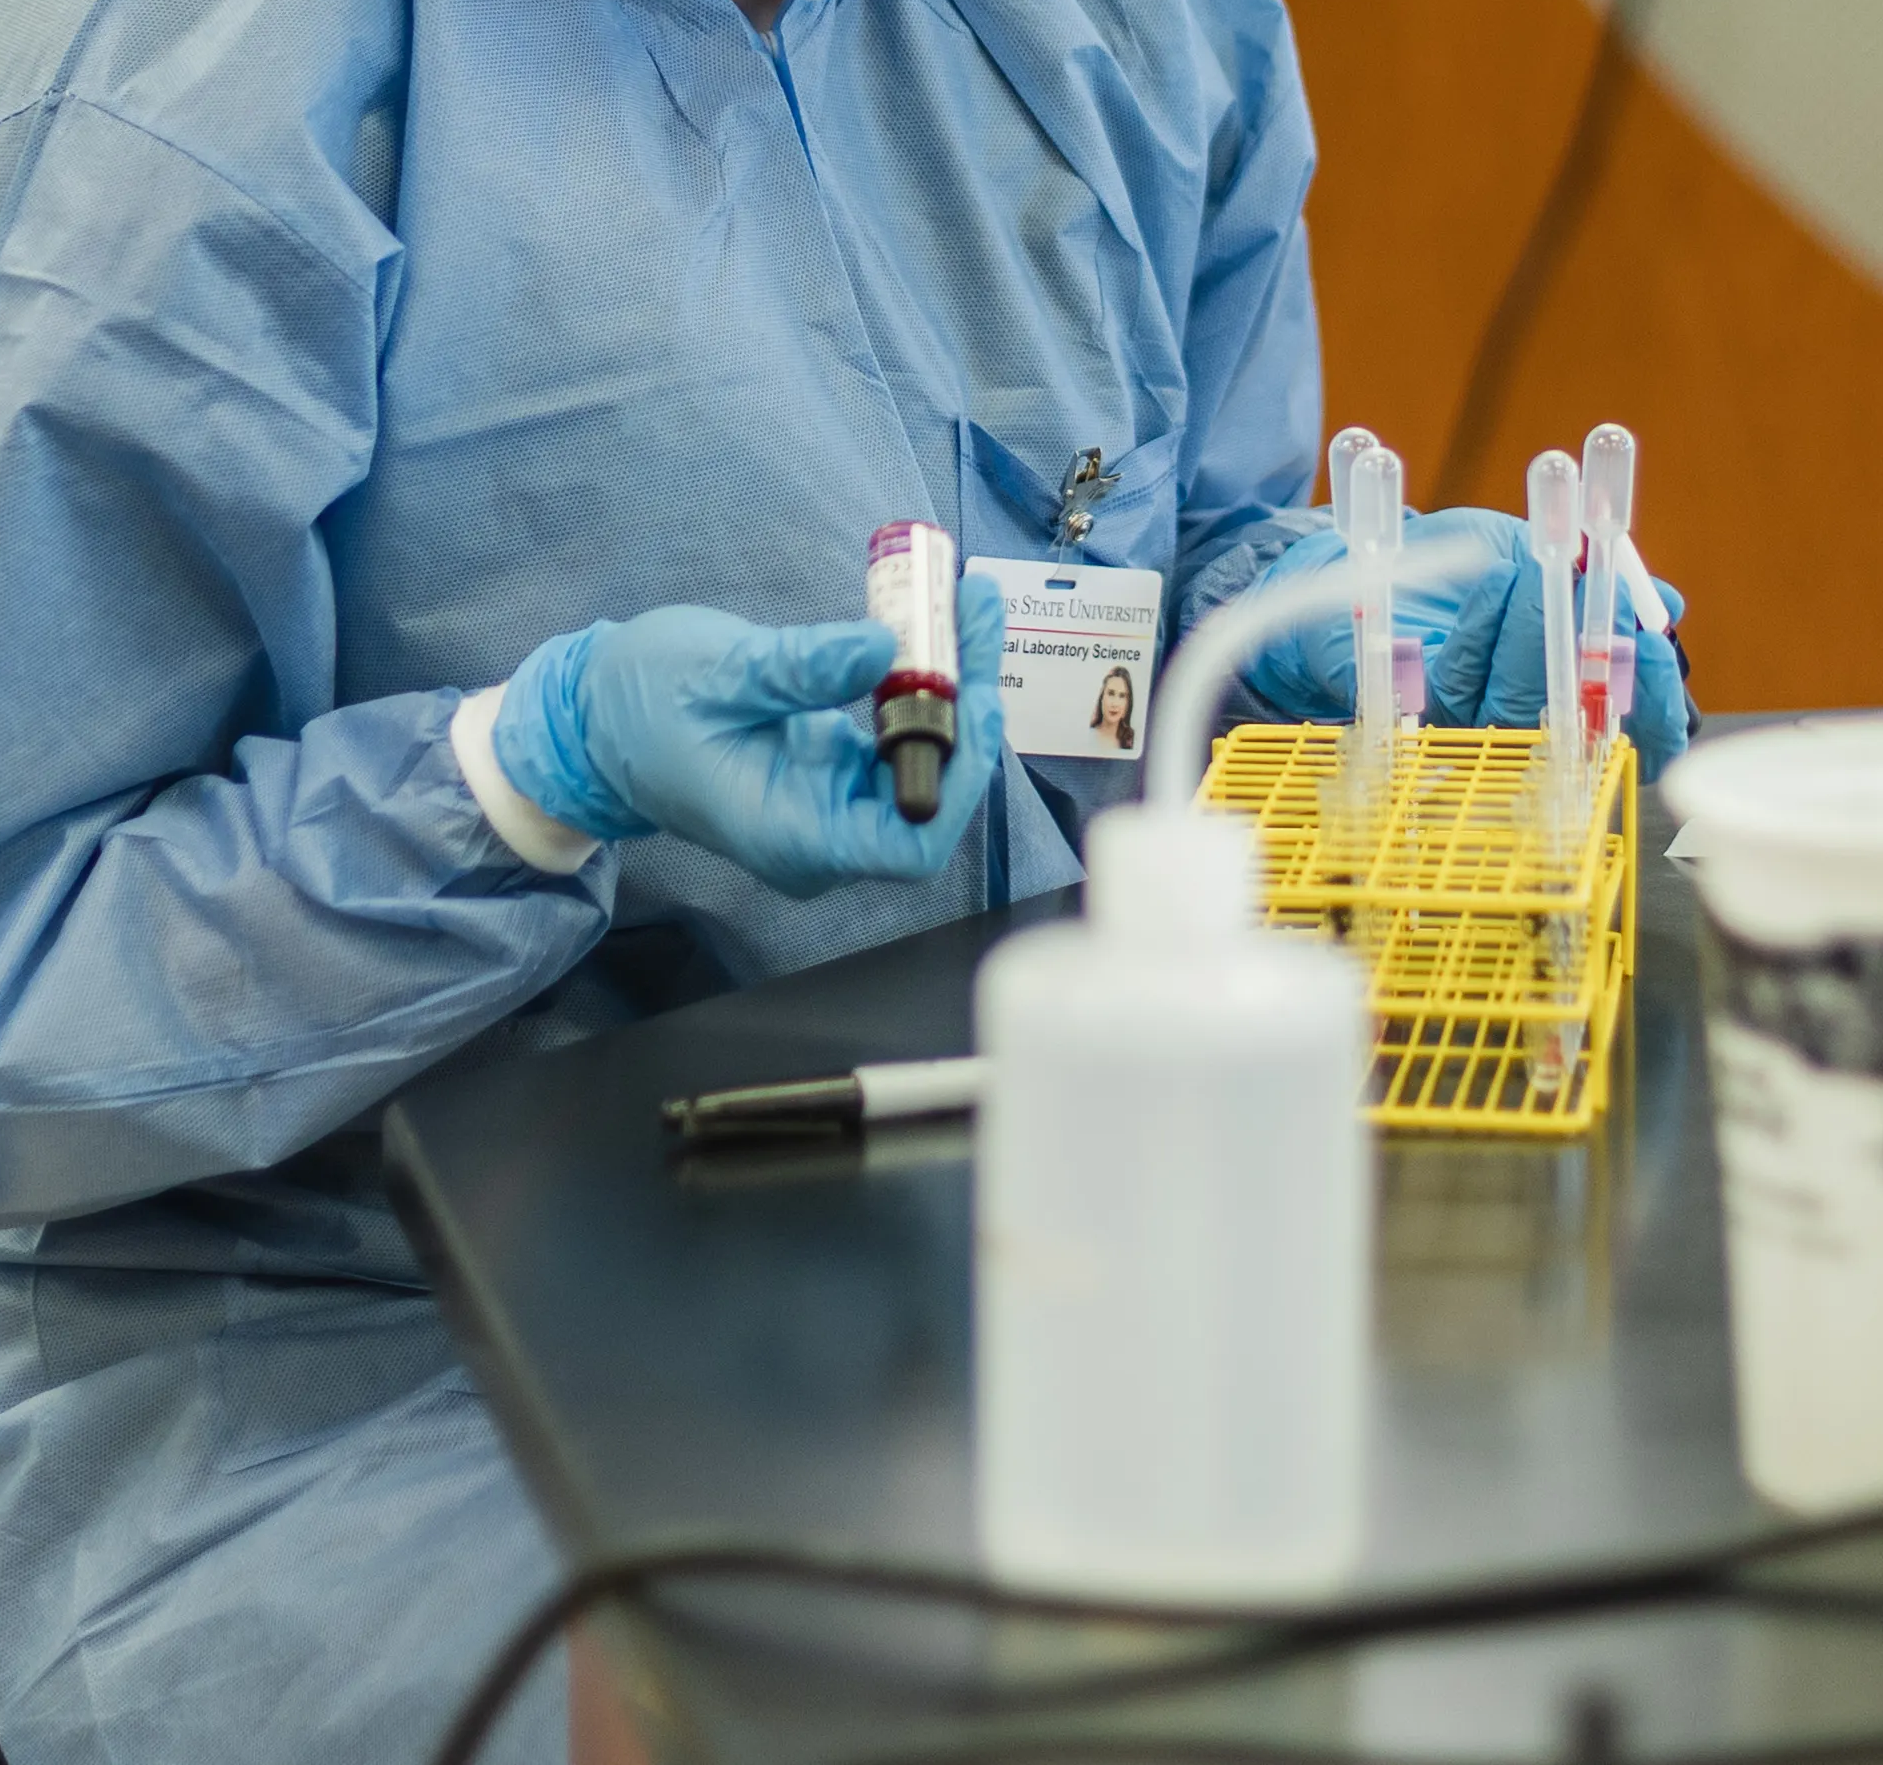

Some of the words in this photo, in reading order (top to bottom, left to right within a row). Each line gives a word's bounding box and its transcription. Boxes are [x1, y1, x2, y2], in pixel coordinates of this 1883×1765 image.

[1004, 597, 1017, 614] IS
[1021, 595, 1065, 618] STATE
[1069, 599, 1155, 624] UNIVERSITY
[1002, 638, 1020, 653] cal
[1023, 638, 1089, 661] Laboratory
[1092, 644, 1141, 661] Science
[997, 672, 1023, 688] ntha
